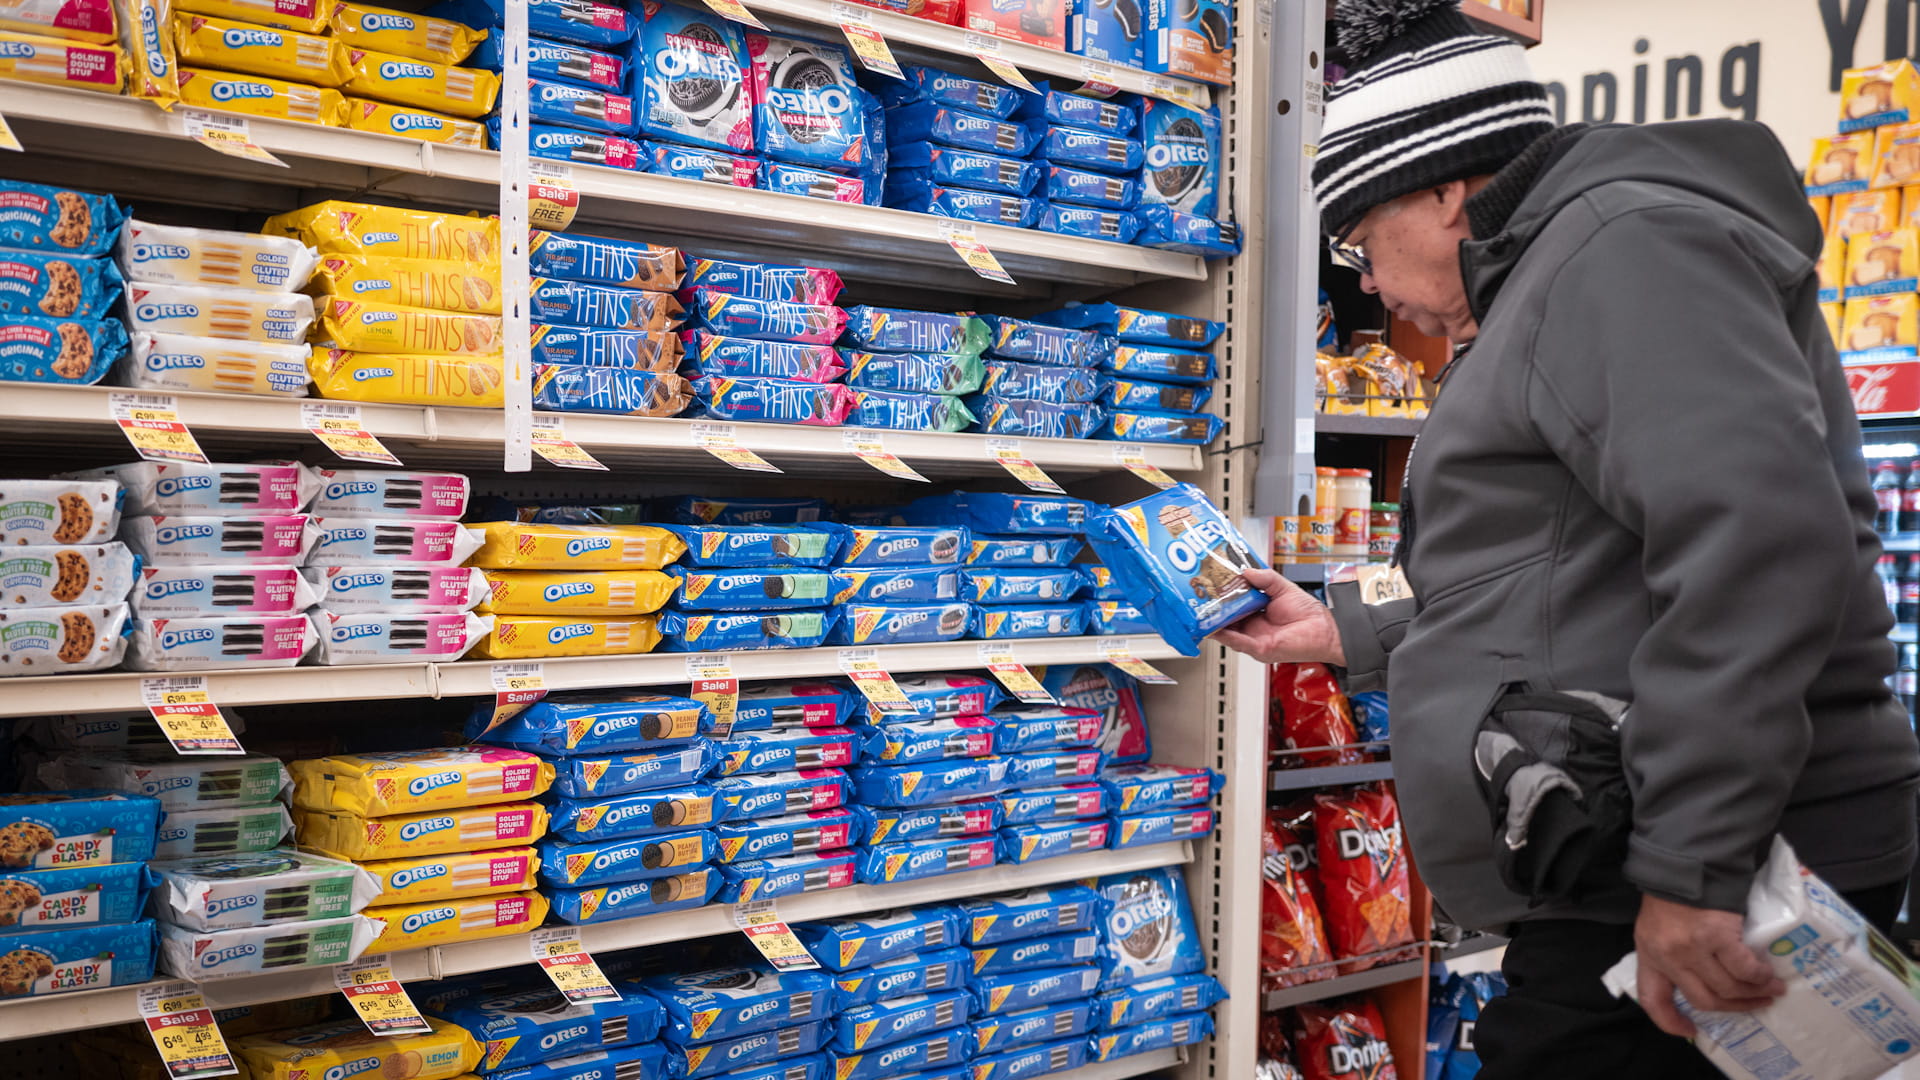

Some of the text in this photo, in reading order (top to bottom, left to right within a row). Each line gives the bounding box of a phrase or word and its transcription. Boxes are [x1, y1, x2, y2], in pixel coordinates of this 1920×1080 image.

[278, 3, 297, 11] STUF
[224, 30, 283, 49] OREO
[667, 34, 729, 56] DOUBLE STUF
[70, 52, 106, 63] GOLDEN
[70, 60, 105, 71] DOUBLE
[656, 49, 740, 80] OREO
[70, 68, 92, 77] STUF
[933, 78, 970, 91] OREO
[212, 83, 273, 101] OREO
[769, 89, 849, 114] OREO
[607, 107, 622, 115] STUF
[1066, 136, 1100, 148] OREO
[1147, 144, 1208, 167] OREO
[952, 158, 990, 170] OREO
[538, 188, 569, 201] Sale!
[533, 209, 565, 220] FREE
[1060, 211, 1093, 224] OREO
[401, 223, 466, 262] THINS
[134, 245, 189, 262] OREO
[256, 254, 288, 264] GOLDEN
[545, 254, 577, 263] TIRAMISU
[546, 241, 636, 281] OREO THINS
[253, 266, 289, 278] GLUTEN
[258, 276, 283, 285] FREE
[353, 280, 391, 292] OREO
[740, 267, 794, 302] THINS
[138, 304, 198, 321] OREO
[263, 322, 297, 332] GLUTEN
[1138, 315, 1167, 328] OREO
[366, 327, 393, 336] LEMON
[400, 311, 462, 352] THINS
[885, 319, 950, 353] OREO THINS
[1, 344, 44, 360] ORIGINAL
[545, 347, 577, 355] TIRAMISU
[579, 333, 636, 369] THINS
[1136, 351, 1167, 363] OREO
[750, 342, 800, 377] THINS
[272, 361, 303, 372] GOLDEN
[267, 374, 304, 385] GLUTEN
[354, 358, 467, 397] OREO THINS
[1024, 374, 1064, 402] THINS
[731, 386, 813, 420] OREO THINS
[131, 420, 173, 430] Sale!
[156, 476, 211, 497] OREO
[432, 491, 463, 499] GLUTEN
[436, 499, 457, 507] FREE
[157, 526, 213, 544] OREO
[730, 533, 769, 548] OREO
[1168, 520, 1225, 572] OREO
[333, 573, 384, 591] OREO
[870, 578, 914, 599] OREO
[147, 579, 204, 599] OREO
[266, 586, 295, 594] GLUTEN
[545, 583, 594, 602] OREO
[1001, 583, 1033, 597] OREO
[274, 633, 304, 642] GLUTEN
[332, 624, 382, 642] OREO
[857, 671, 882, 680] Sale!
[702, 681, 729, 692] Sale!
[507, 691, 538, 703] Sale!
[164, 705, 205, 714] Sale!
[904, 740, 940, 758] OREO
[505, 768, 530, 777] GOLDEN
[505, 774, 530, 783] DOUBLE
[943, 767, 977, 785] OREO
[247, 779, 277, 789] GLUTEN
[410, 771, 461, 795] OREO
[505, 781, 521, 789] STUF
[252, 786, 272, 795] FREE
[815, 791, 834, 799] DOUBLE
[1019, 796, 1052, 813] OREO
[499, 814, 525, 823] GOLDEN
[499, 820, 525, 829] DOUBLE
[244, 830, 276, 841] GLUTEN
[401, 818, 454, 841] OREO
[498, 827, 515, 835] STUF
[822, 831, 842, 840] DOUBLE
[56, 840, 102, 853] CANDY
[248, 837, 270, 847] FREE
[52, 849, 100, 863] BLASTS
[595, 848, 639, 869] OREO
[492, 860, 520, 870] GOLDEN
[492, 867, 520, 876] DOUBLE
[391, 864, 447, 889] OREO
[492, 874, 509, 883] STUF
[43, 895, 88, 910] CANDY
[315, 894, 349, 905] GLUTEN
[499, 901, 525, 910] GOLDEN
[39, 905, 87, 921] BLASTS
[320, 902, 343, 913] FREE
[498, 907, 524, 916] DOUBLE
[402, 908, 456, 933] OREO
[498, 914, 515, 923] STUF
[1110, 900, 1172, 933] OREO
[752, 924, 779, 935] Sale!
[313, 941, 348, 953] GLUTEN
[550, 946, 564, 955] 699
[202, 944, 256, 968] OREO
[318, 949, 341, 961] FREE
[550, 955, 581, 965] Sale!
[55, 964, 100, 979] CANDY
[356, 972, 373, 984] 699
[51, 973, 99, 989] BLASTS
[354, 983, 390, 994] Sale!
[360, 999, 403, 1012] 649 499
[1145, 990, 1174, 1009] OREO
[163, 1001, 182, 1012] 699
[738, 1000, 779, 1022] OREO
[160, 1013, 200, 1026] Sale!
[163, 1032, 212, 1049] 649 499
[541, 1025, 588, 1049] OREO
[728, 1037, 768, 1060] OREO
[427, 1051, 460, 1064] LEMON
